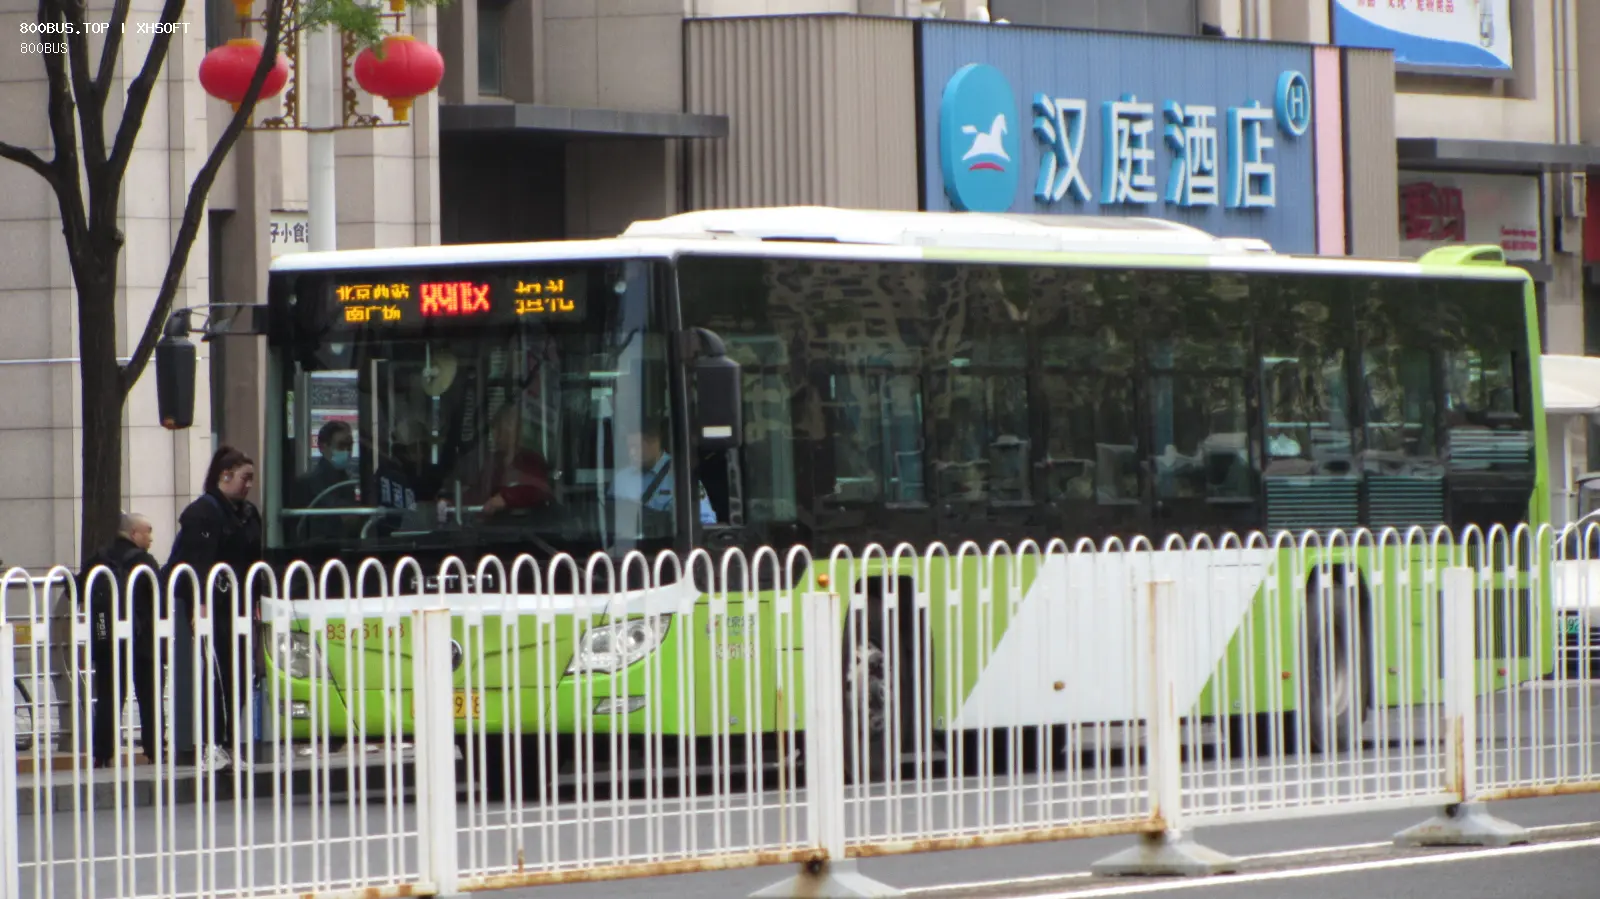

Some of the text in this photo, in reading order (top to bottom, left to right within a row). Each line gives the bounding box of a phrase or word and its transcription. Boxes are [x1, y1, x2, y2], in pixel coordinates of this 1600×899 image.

[1033, 92, 1277, 208] 汉庭酒店
[335, 283, 410, 301] 北京西站
[344, 304, 402, 323] 南广场
